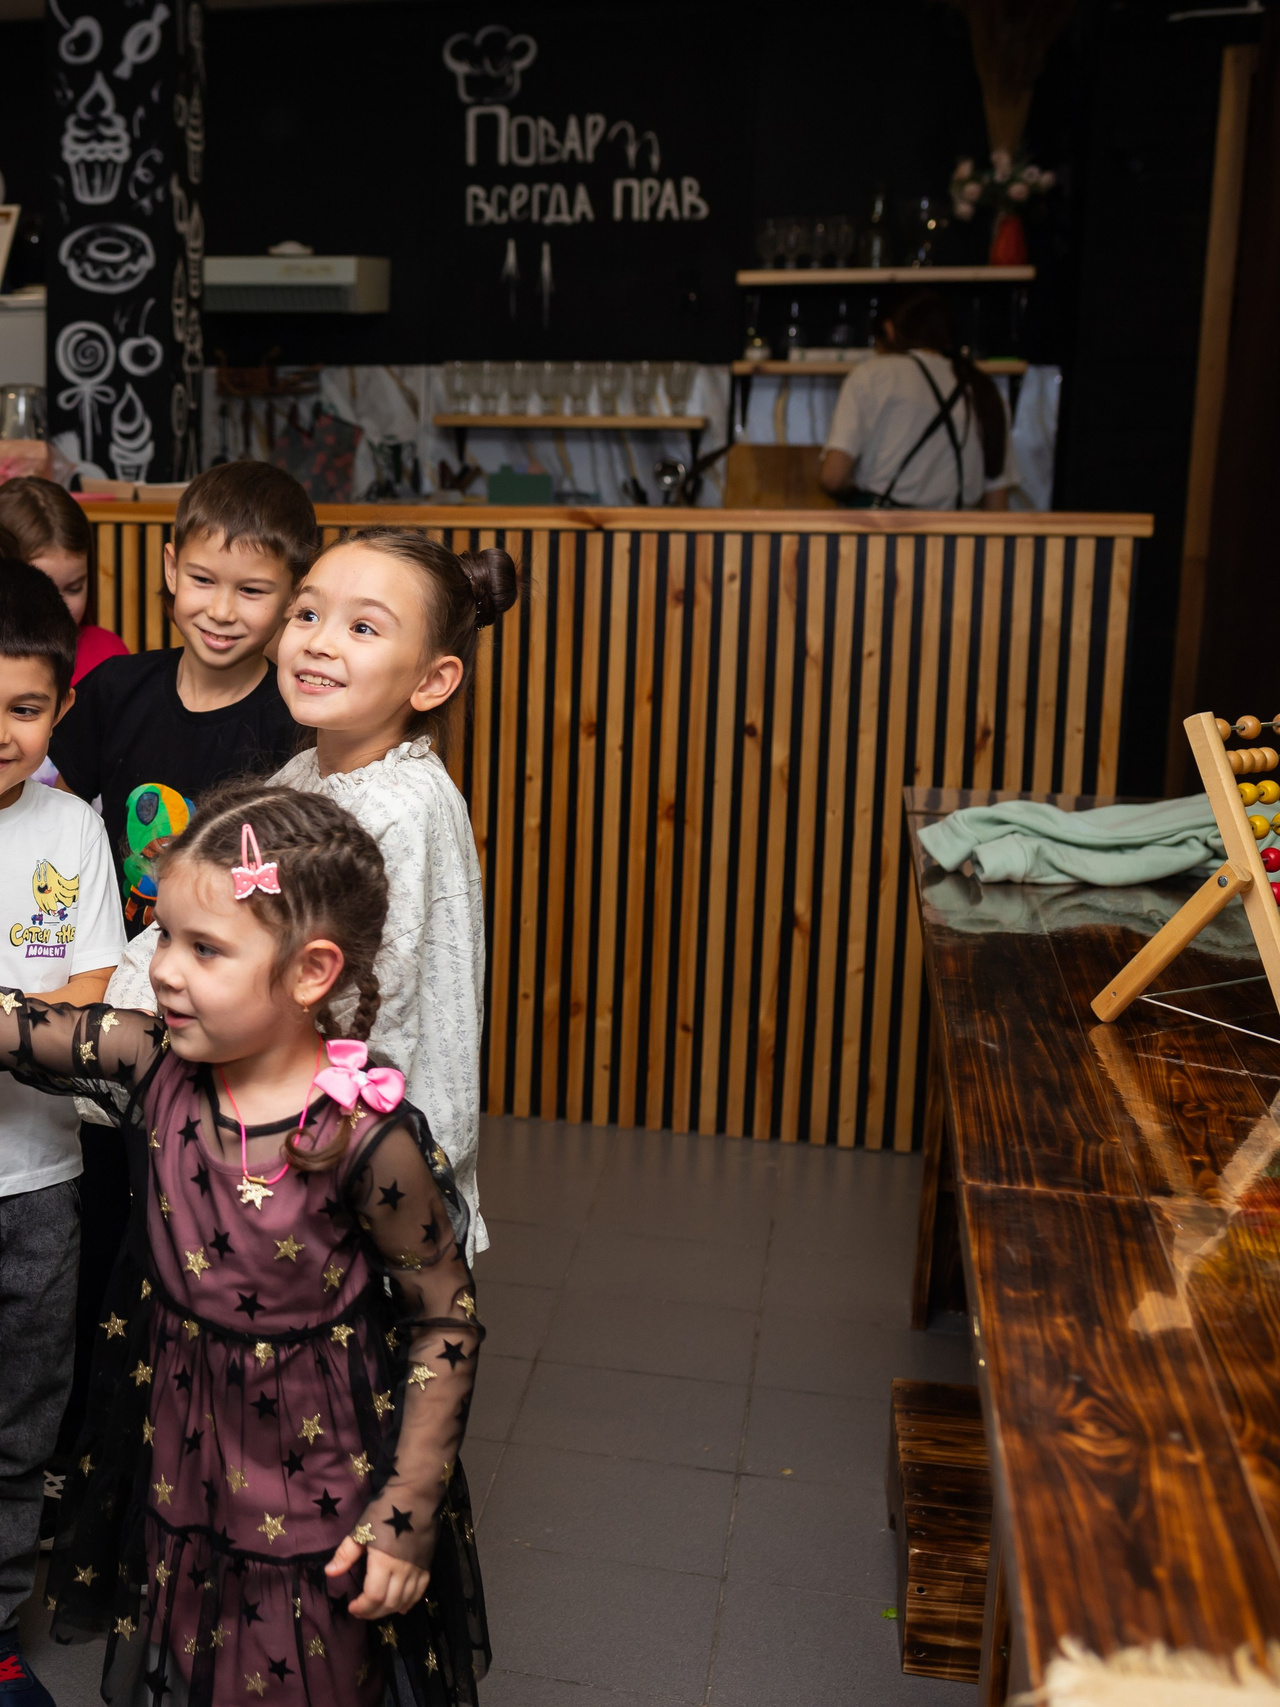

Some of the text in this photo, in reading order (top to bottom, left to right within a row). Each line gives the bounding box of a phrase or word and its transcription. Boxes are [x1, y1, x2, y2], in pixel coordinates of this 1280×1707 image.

[613, 176, 709, 221] ПРАВ
[10, 923, 51, 947] CATCH
[28, 945, 65, 957] MOMENT
